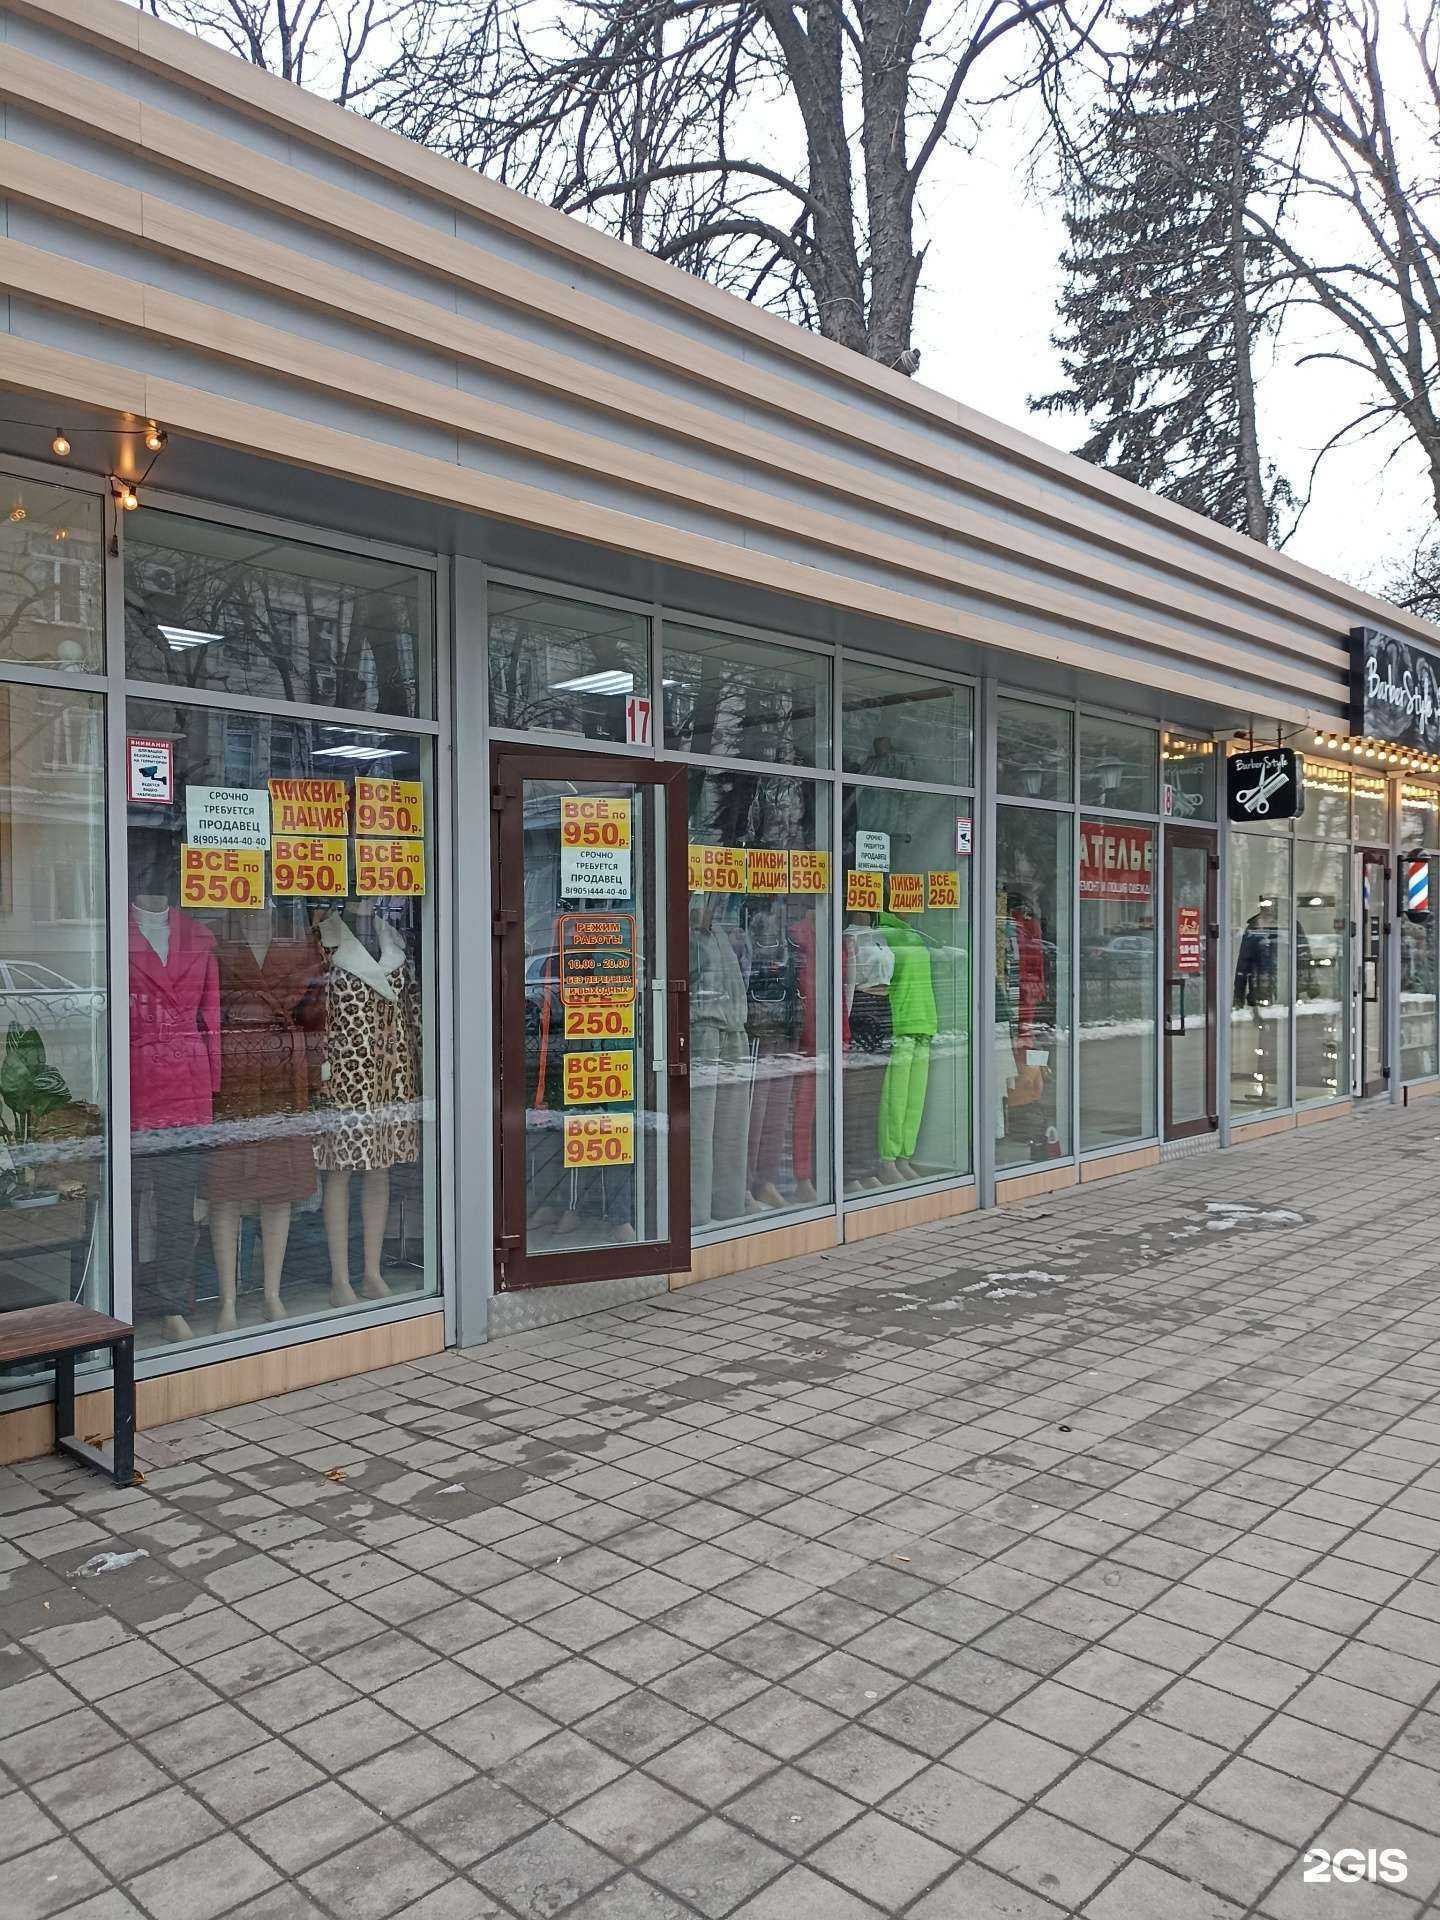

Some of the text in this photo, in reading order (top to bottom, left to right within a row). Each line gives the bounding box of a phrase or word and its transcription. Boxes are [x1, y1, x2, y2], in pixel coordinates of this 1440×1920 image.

[627, 699, 650, 743] 17
[130, 740, 170, 749] ВНИМАНИЕ
[209, 791, 249, 802] СРОЧНО
[359, 782, 418, 804] ВСЁ по
[204, 805, 255, 815] ТРЕБУЕТСЯ
[282, 805, 344, 831] ДАЦИЯ
[358, 804, 422, 834] 950р.
[565, 799, 626, 820] ВСЁ по
[199, 819, 260, 833] ПРОДАВЕЦ
[564, 822, 629, 847] 950р.
[276, 839, 342, 862] ВСЁ по
[359, 842, 404, 863] ВСЁ
[580, 850, 614, 859] СРОЧНО
[704, 849, 733, 866] ВСЁ
[1080, 833, 1152, 872] АТЕЛЬЕ
[243, 864, 260, 873] по
[576, 861, 618, 871] ТРЕБУЕТСЯ
[275, 863, 346, 893] 950р.
[359, 866, 424, 893] 550р.
[571, 874, 623, 884] ПРОДАВЕЦ
[752, 871, 788, 891] ДАЦИЯ
[185, 874, 262, 905] 550р.
[893, 893, 923, 909] ДАЦИЯ
[576, 922, 621, 933] РЕЖИМ
[573, 935, 623, 945] РАБОТЫ
[567, 1012, 632, 1035] 250р.
[567, 1053, 629, 1073] ВСЁ по
[567, 1075, 632, 1099] 550р.
[568, 1115, 629, 1136] ВСЁ по
[567, 1137, 632, 1162] 950р.
